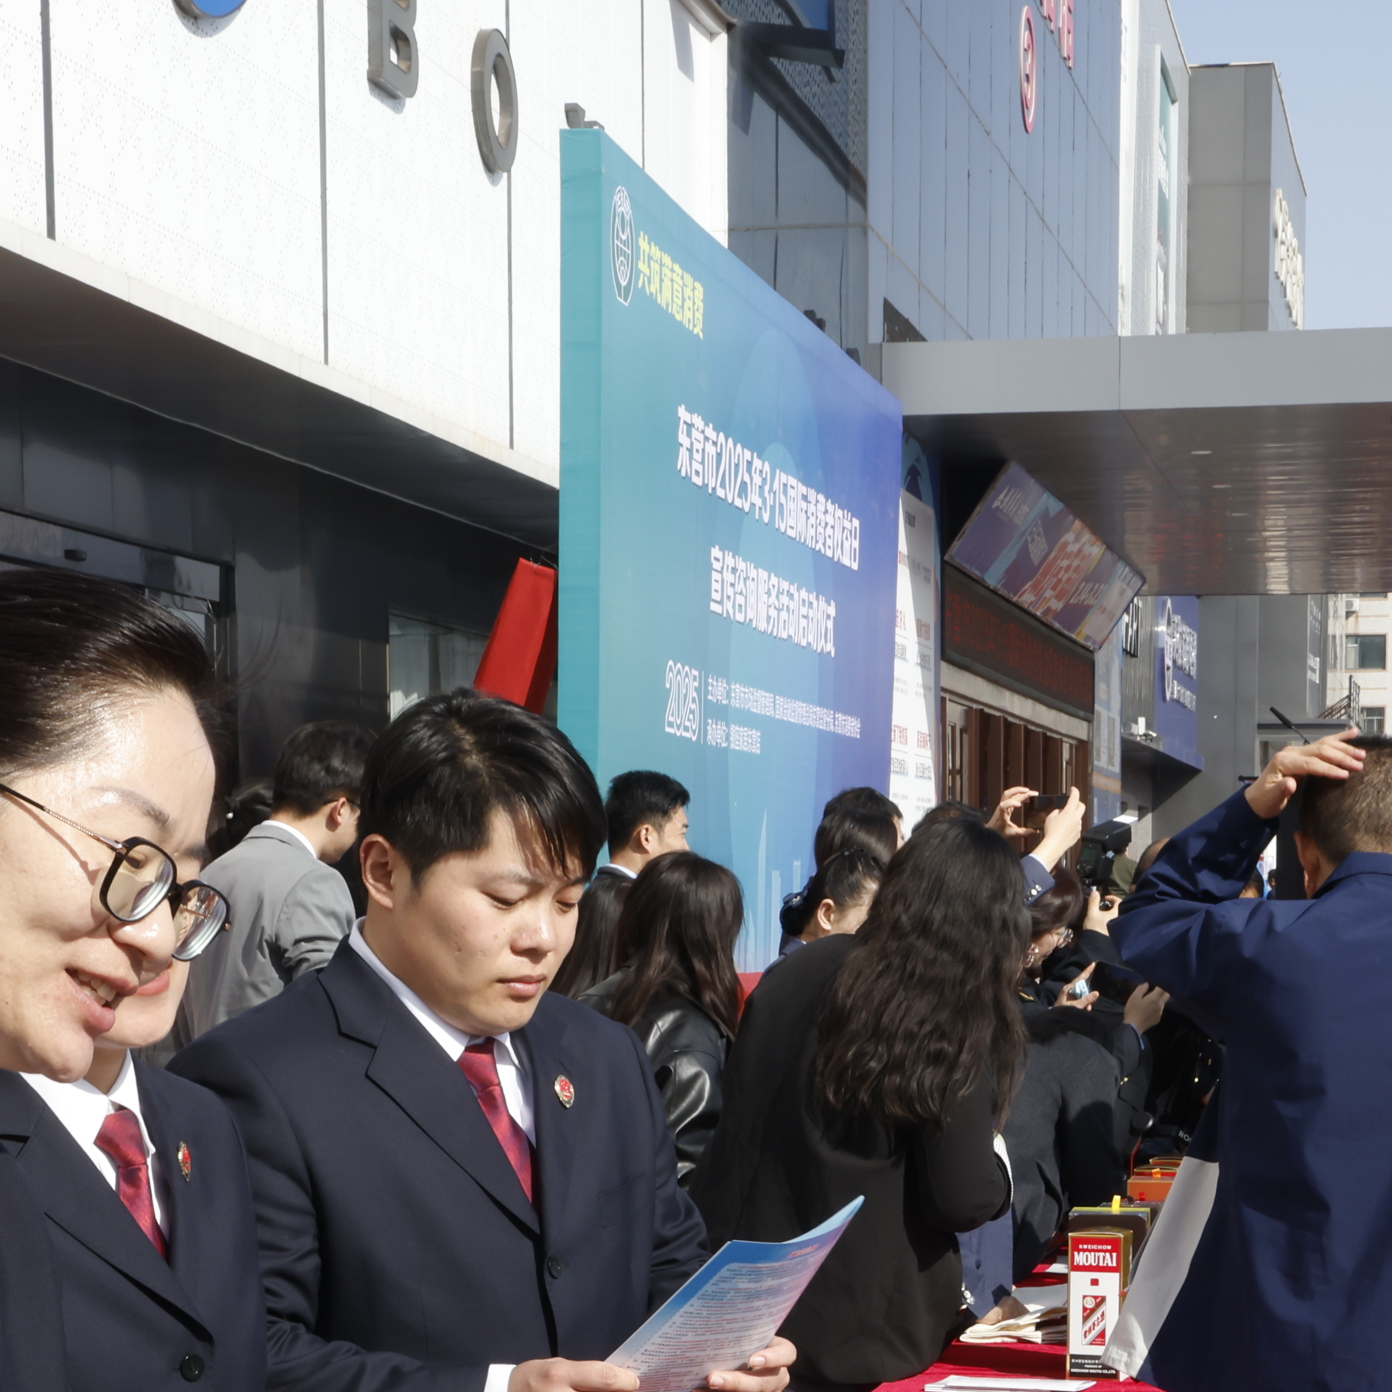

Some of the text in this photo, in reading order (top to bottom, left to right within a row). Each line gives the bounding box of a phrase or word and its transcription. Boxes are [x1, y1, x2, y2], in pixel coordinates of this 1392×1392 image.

[638, 230, 704, 339] 共筑满意消费
[710, 545, 836, 657] 宣传咨询服务活动启动仪式
[665, 660, 699, 741] 2025
[1074, 1251, 1117, 1267] MOUTAI
